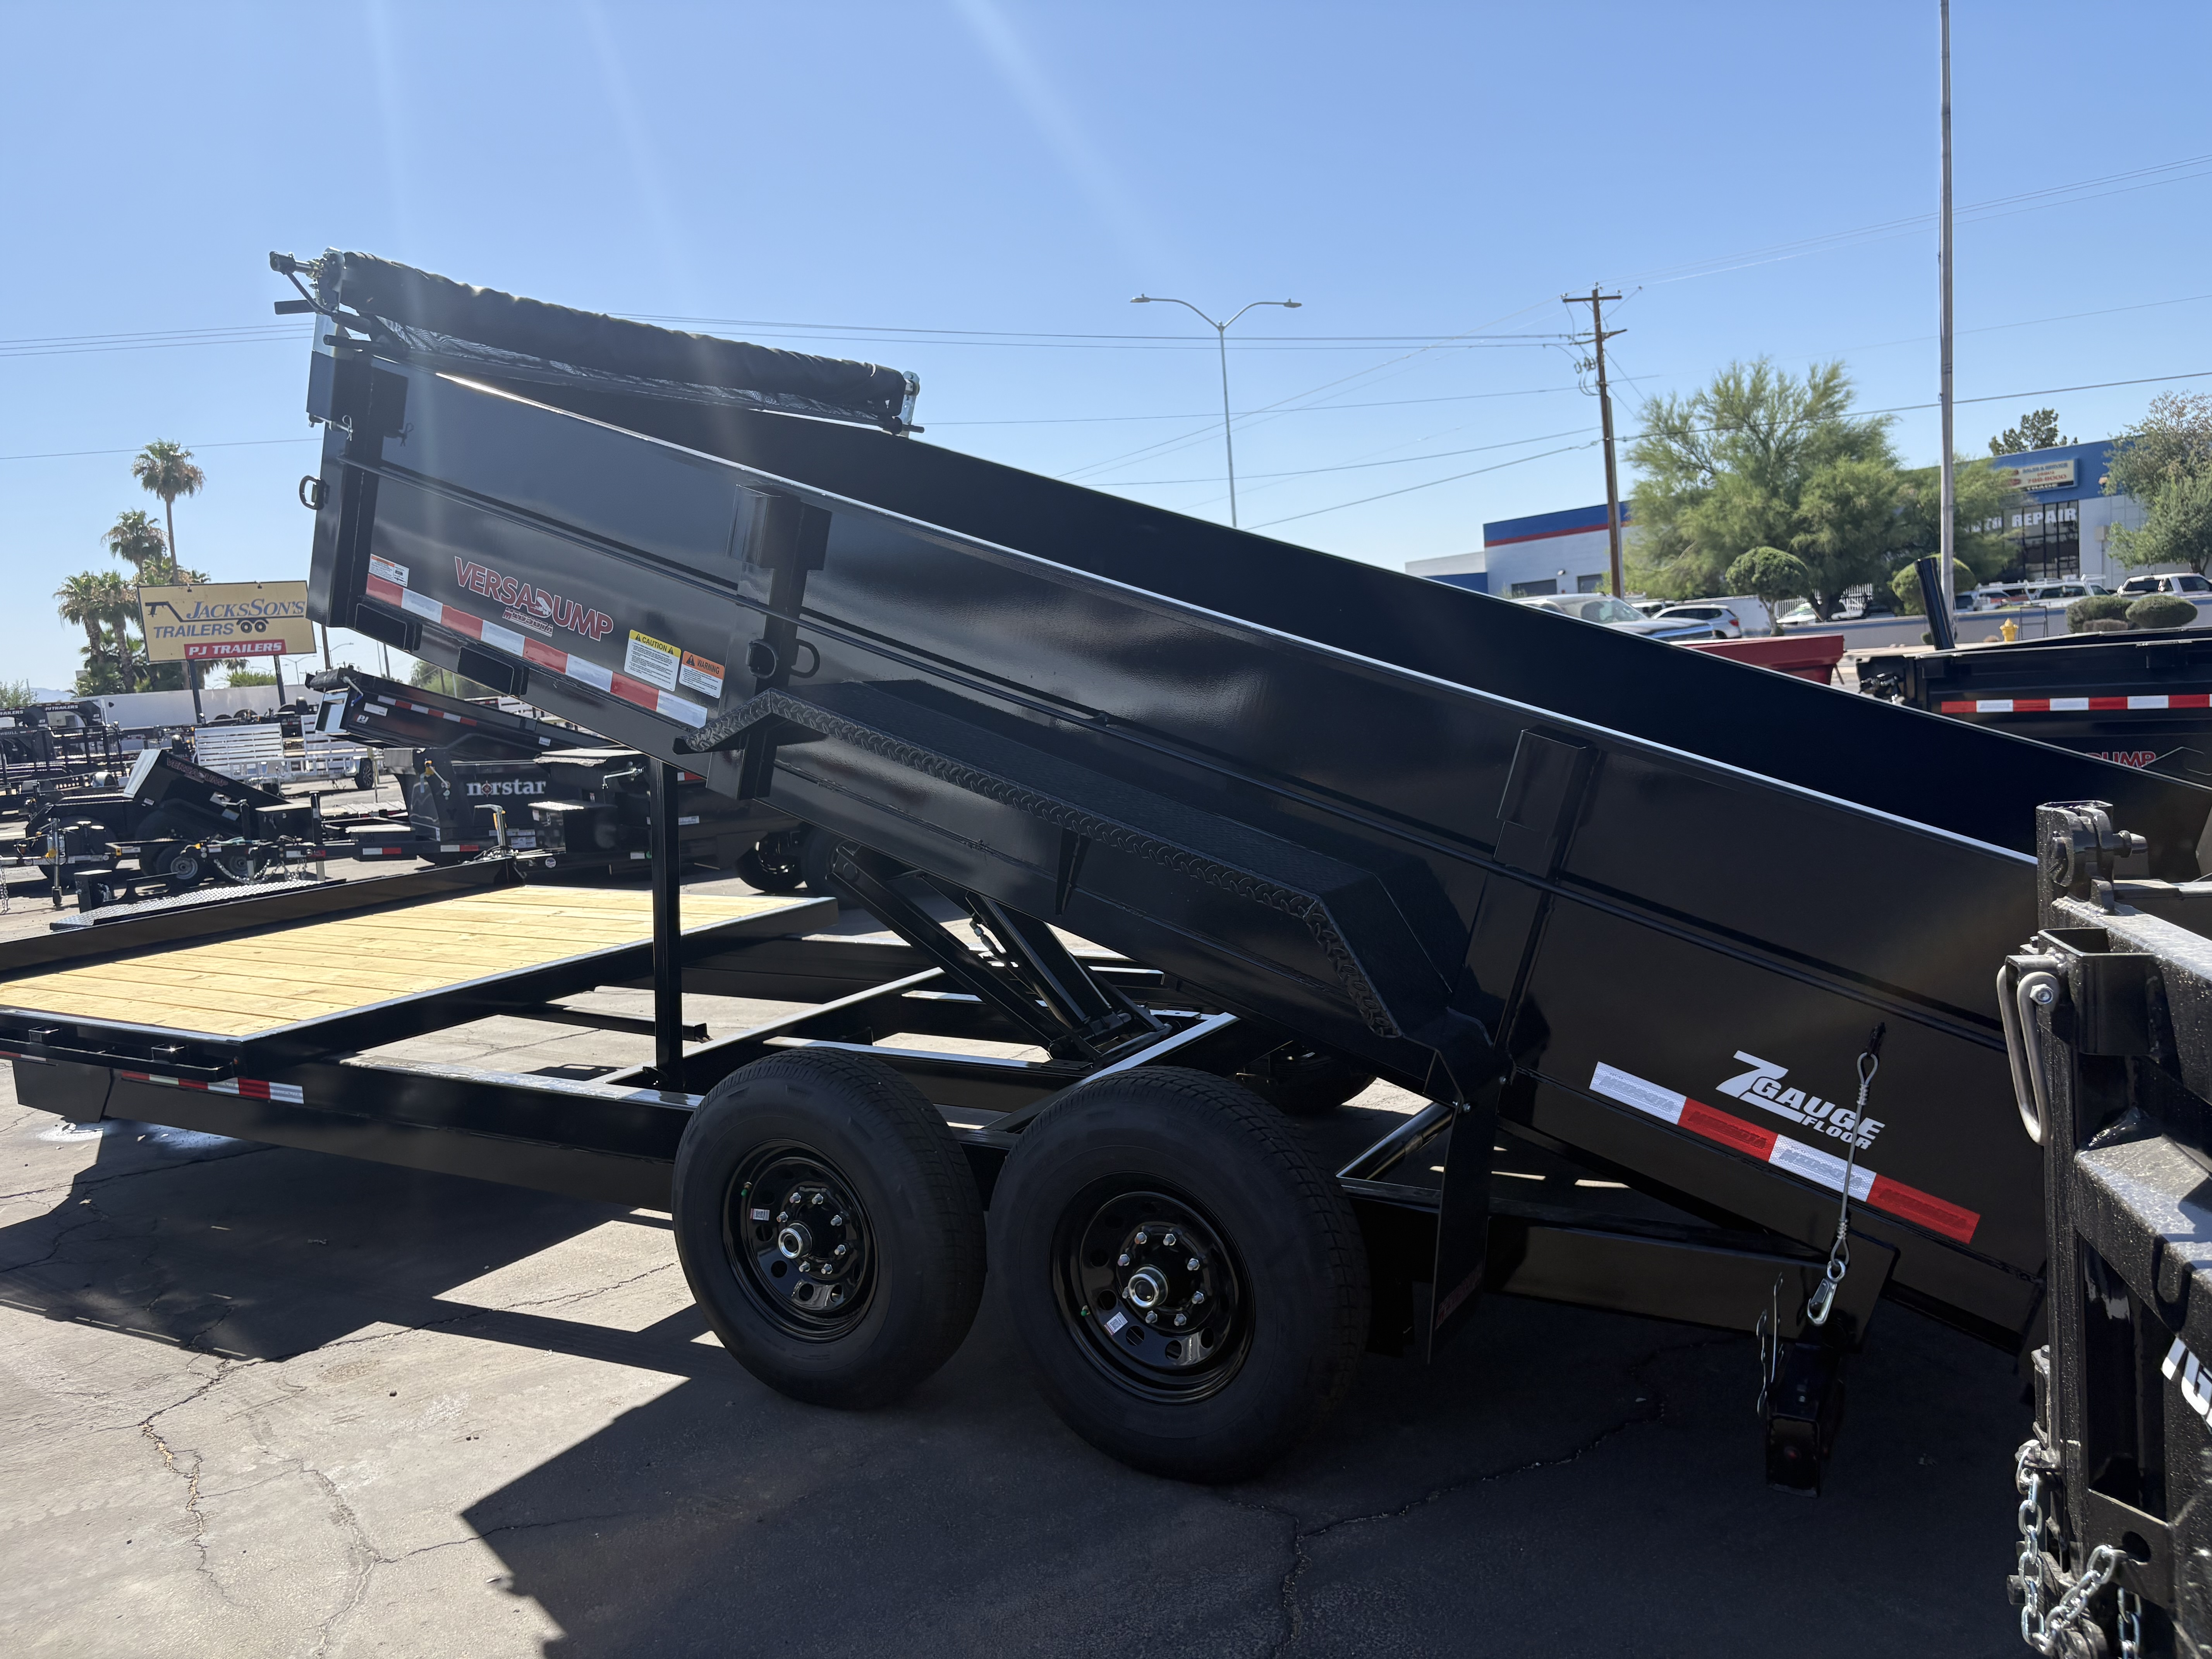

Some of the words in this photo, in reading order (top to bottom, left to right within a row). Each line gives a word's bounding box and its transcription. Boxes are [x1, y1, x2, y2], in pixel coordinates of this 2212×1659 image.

[2012, 508, 2076, 528] REPAIR
[455, 556, 613, 642] VERSADUMP
[153, 623, 234, 638] TRAILERS
[189, 646, 207, 656] PJ
[213, 642, 282, 654] TRAILERS
[642, 637, 667, 652] CAUTION
[697, 659, 720, 675] WARNING
[466, 779, 547, 797] norstar
[1716, 1050, 1789, 1098] 7
[1752, 1077, 1885, 1140] GAUGE
[1802, 1115, 1872, 1150] FLOOR
